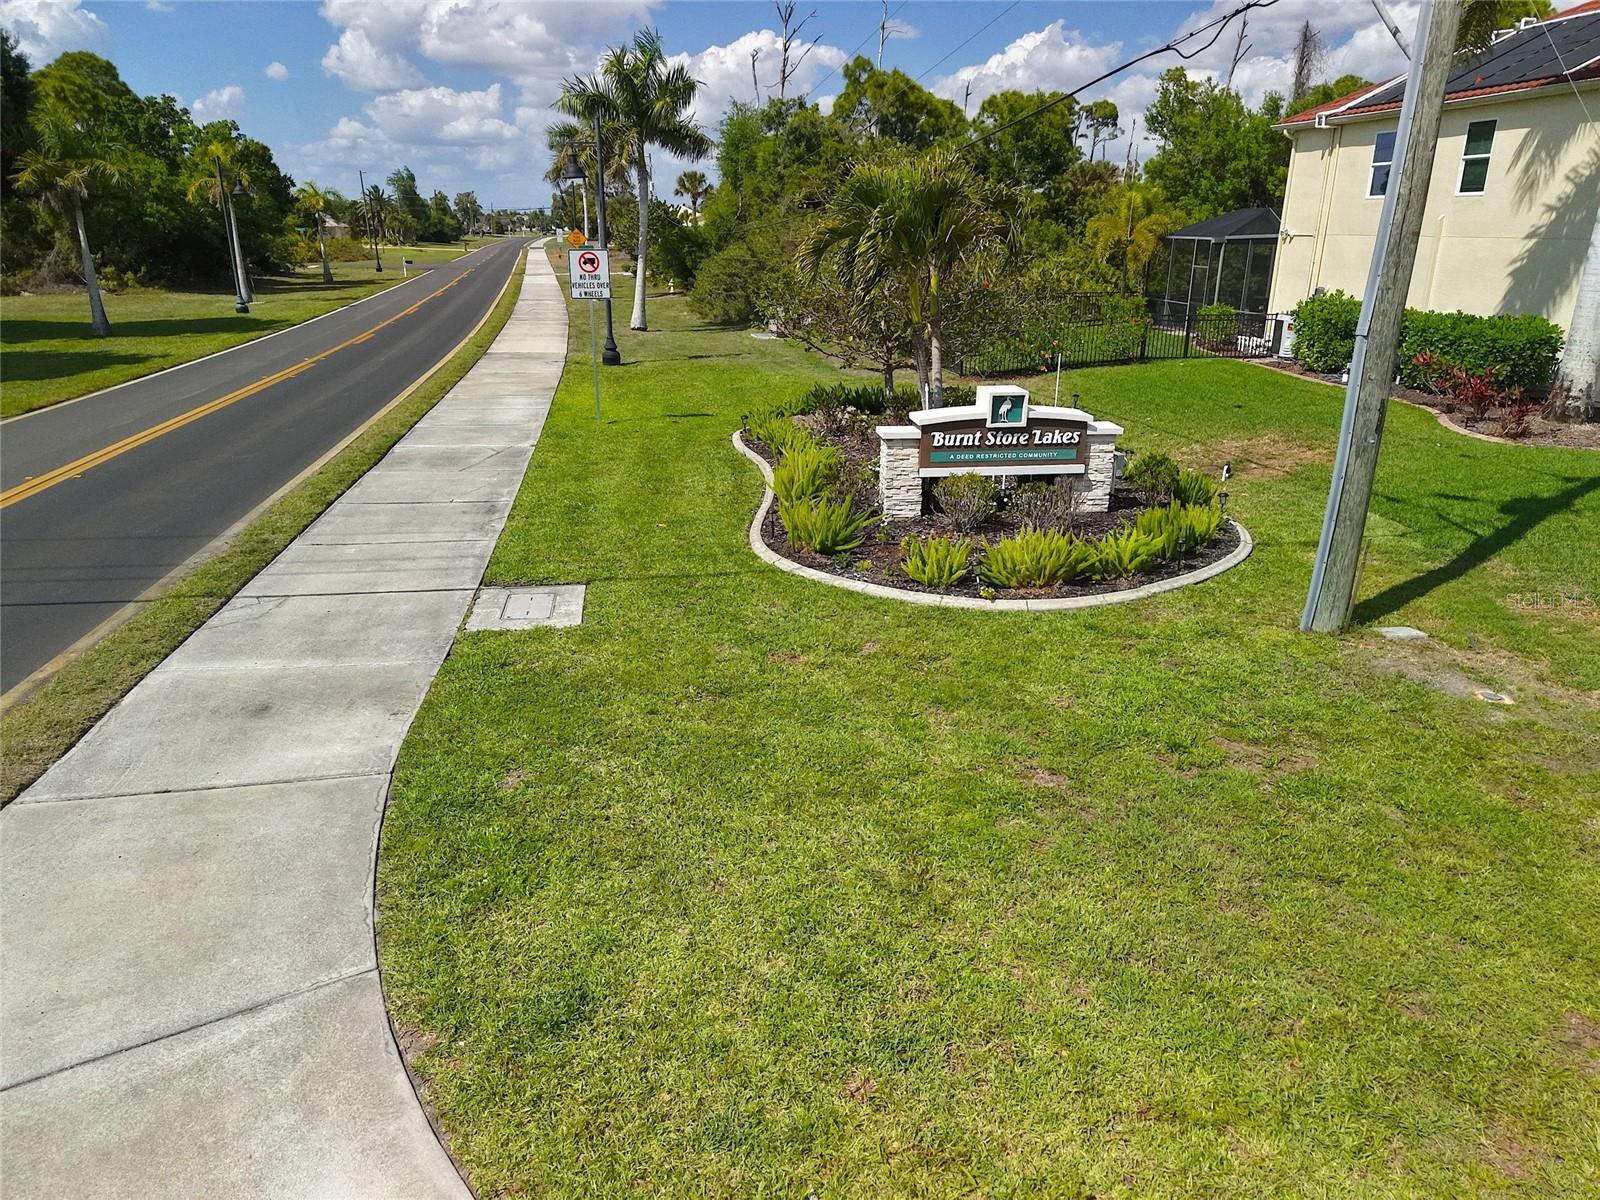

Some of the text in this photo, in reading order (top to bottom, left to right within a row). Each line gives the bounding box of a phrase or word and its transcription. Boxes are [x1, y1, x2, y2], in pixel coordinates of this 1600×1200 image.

[931, 430, 1081, 447] Burnt Store Lakes
